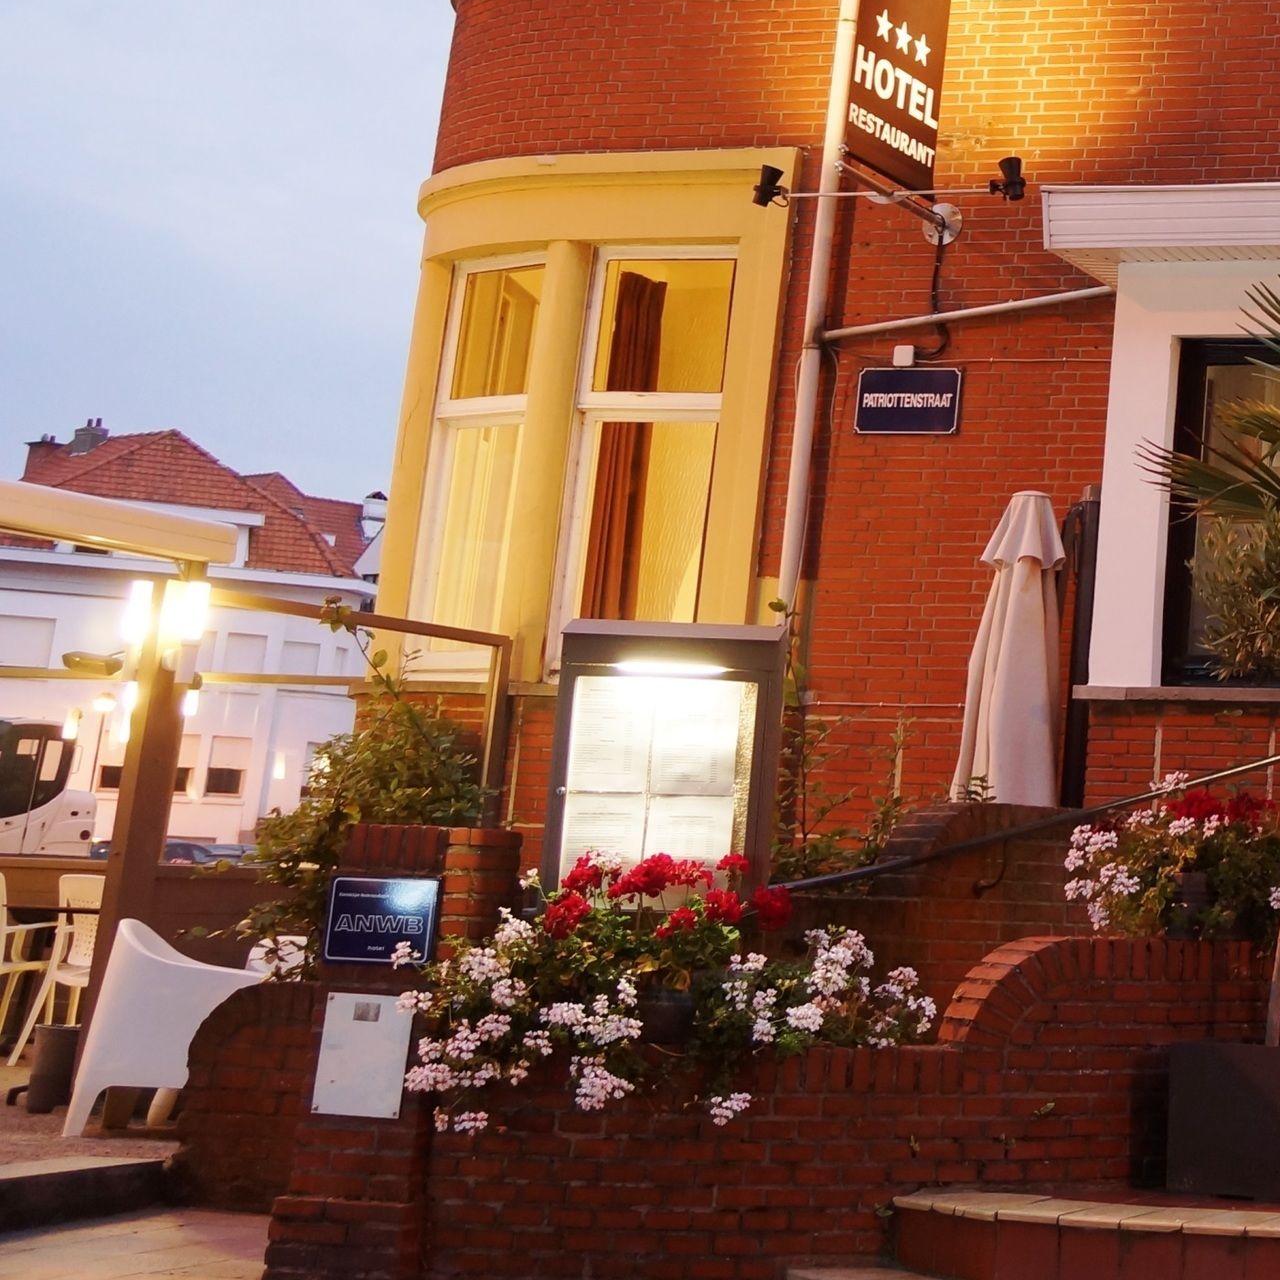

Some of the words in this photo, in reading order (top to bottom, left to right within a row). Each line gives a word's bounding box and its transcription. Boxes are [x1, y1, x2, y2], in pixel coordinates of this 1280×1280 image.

[854, 44, 938, 130] HOTEL
[848, 102, 935, 167] RESTAURANT
[862, 393, 953, 408] PATRIOTTENSTRAAT
[334, 913, 424, 934] ANWB
